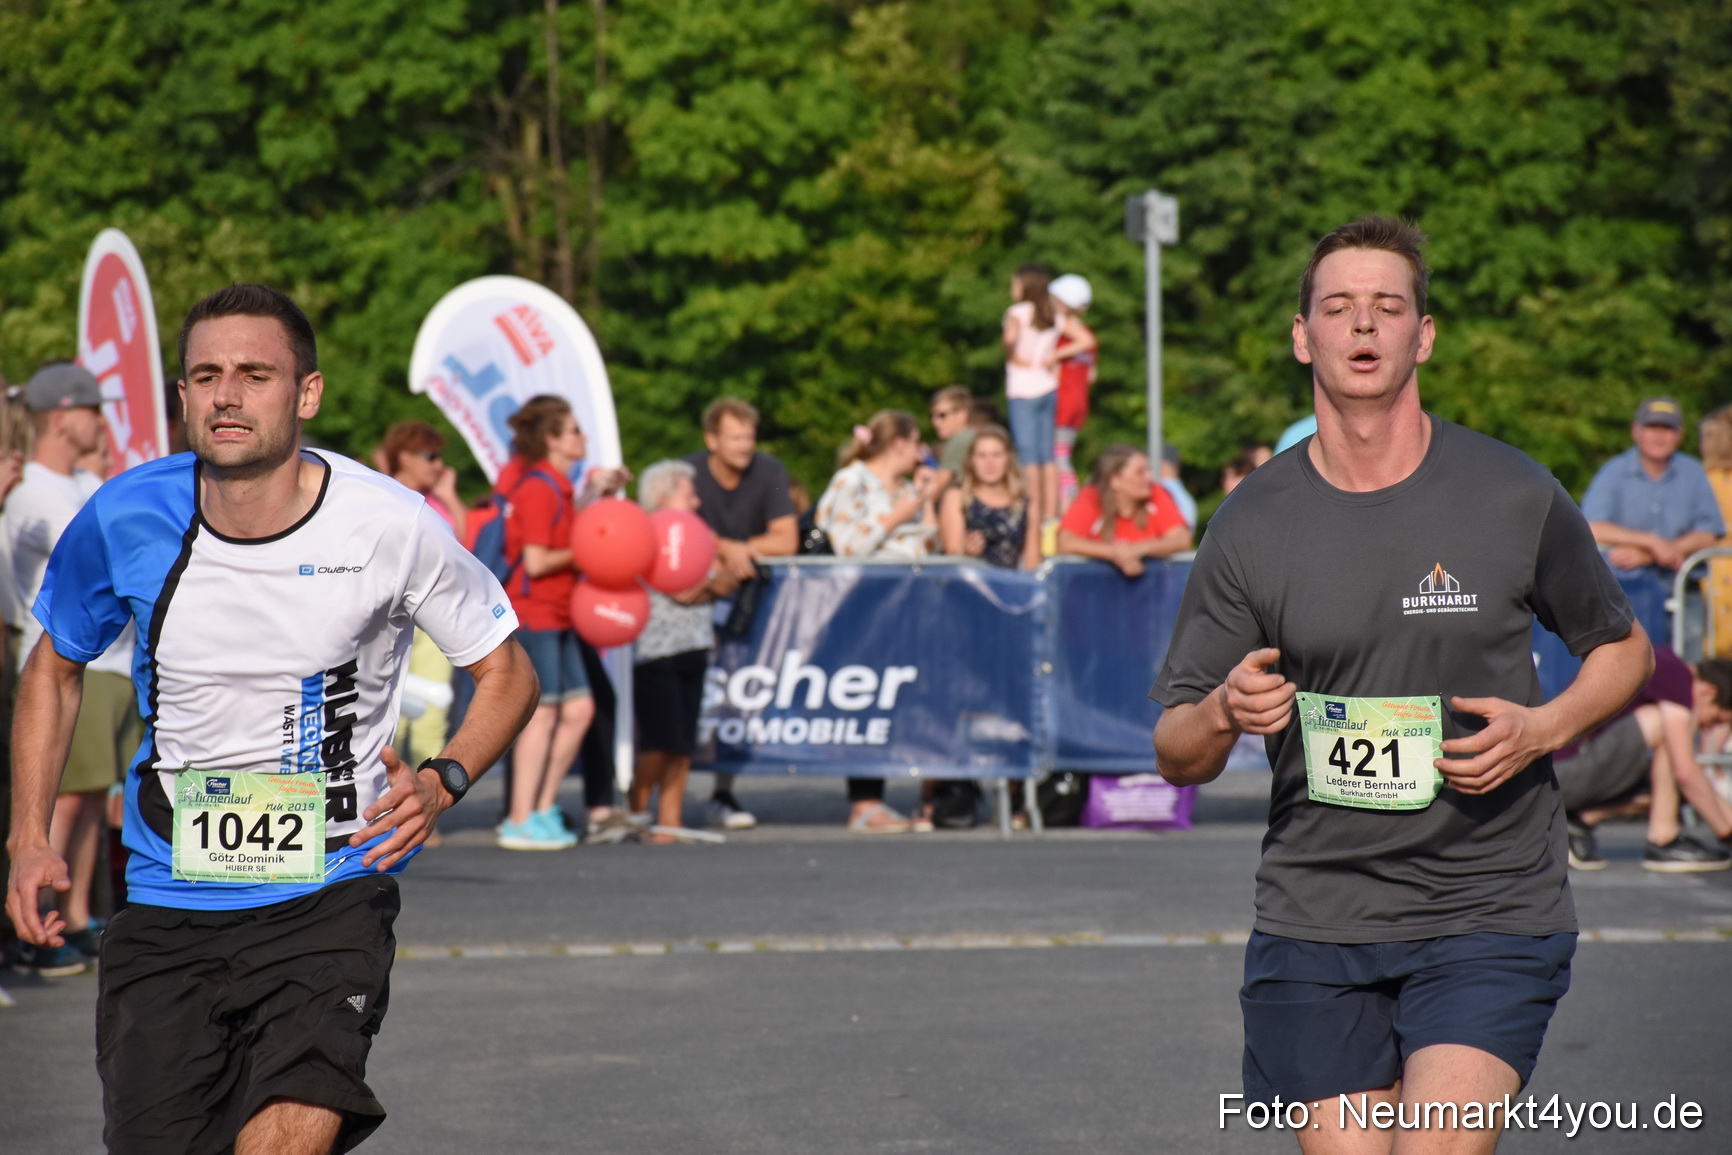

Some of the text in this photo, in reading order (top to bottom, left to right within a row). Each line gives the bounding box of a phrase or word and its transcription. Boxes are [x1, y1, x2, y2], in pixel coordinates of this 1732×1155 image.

[1402, 594, 1478, 608] BURKHARDT
[282, 704, 296, 745] WASTE
[1318, 714, 1368, 731] firmenlauf
[1403, 727, 1432, 737] 2019
[1328, 737, 1400, 778] 421
[1326, 775, 1416, 790] Lederer Bernhard
[196, 791, 253, 804] firmenlauf
[1340, 789, 1373, 798] Burkhardt
[287, 803, 315, 812] 2019
[193, 811, 303, 851] 1042
[208, 853, 285, 864] Götz Dominik
